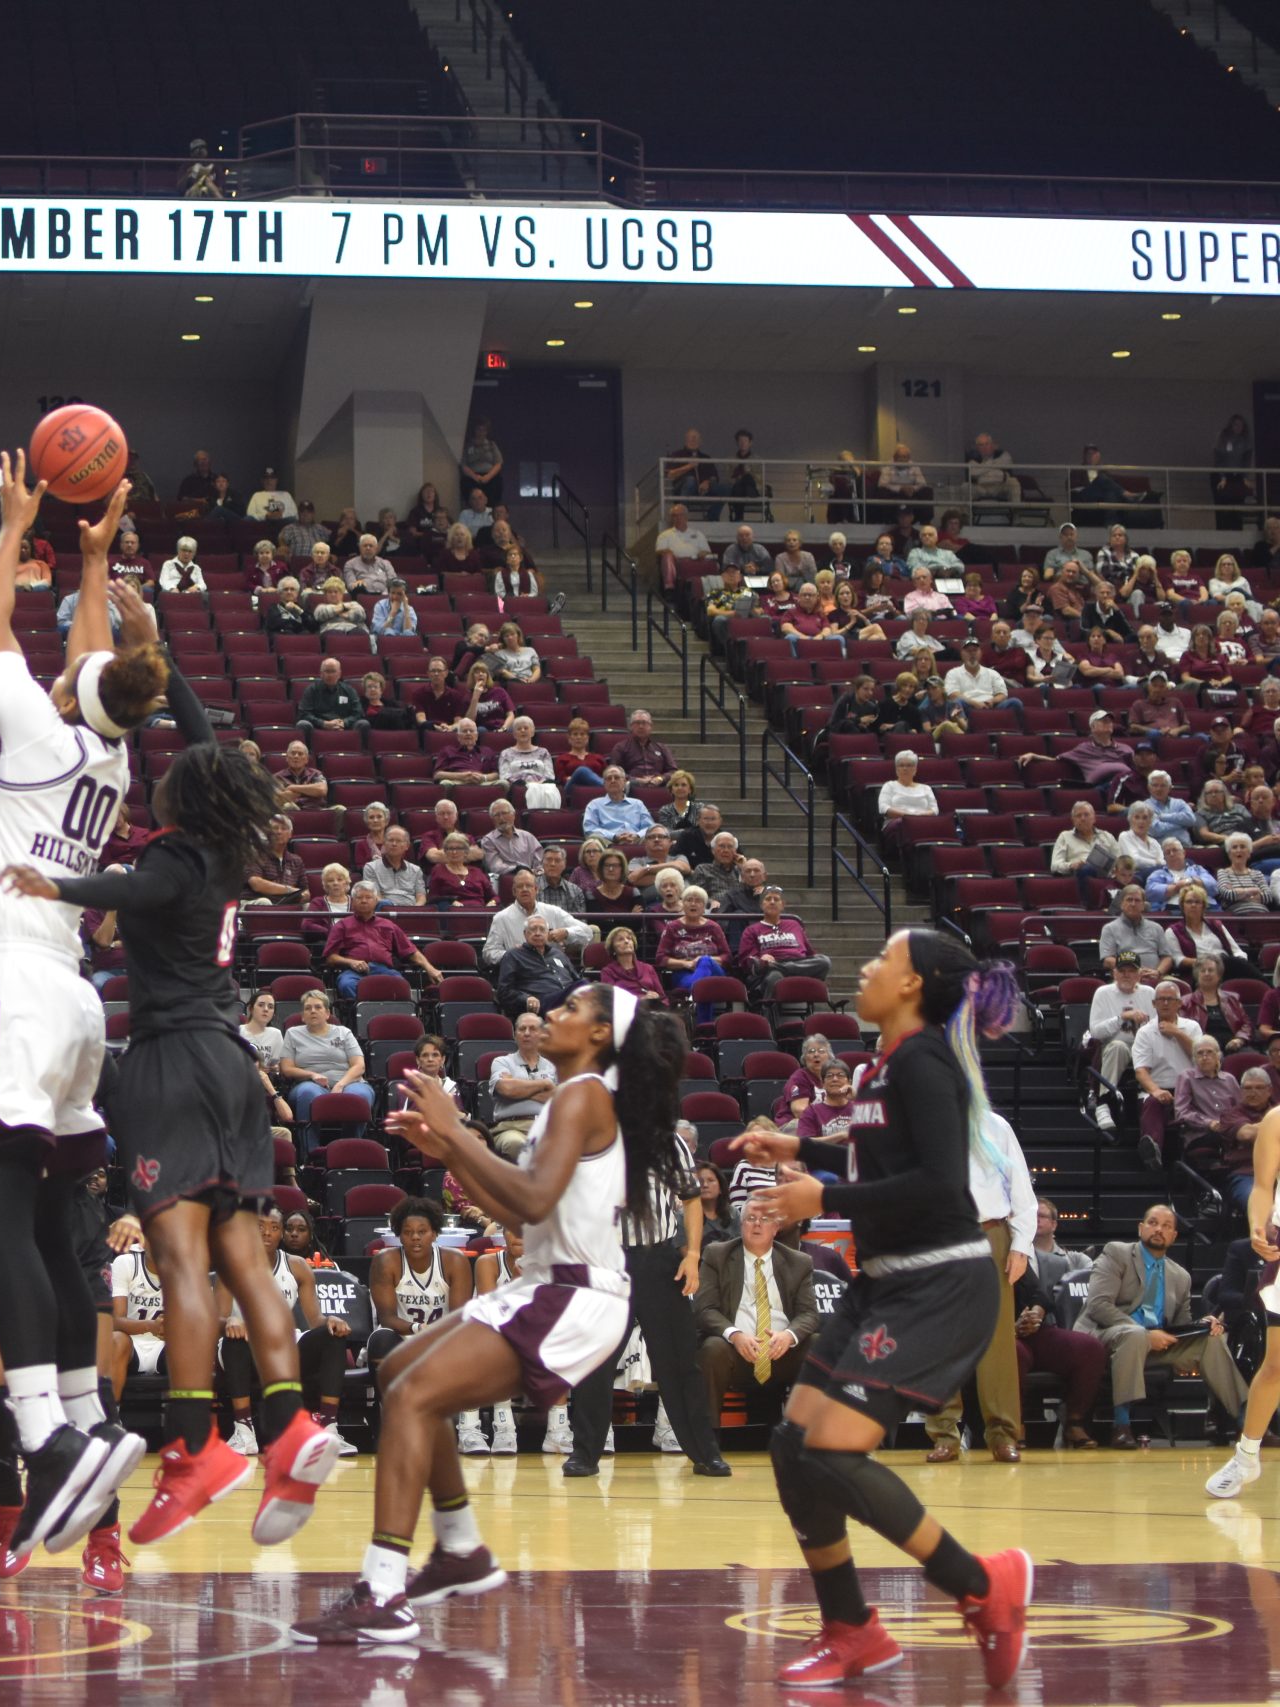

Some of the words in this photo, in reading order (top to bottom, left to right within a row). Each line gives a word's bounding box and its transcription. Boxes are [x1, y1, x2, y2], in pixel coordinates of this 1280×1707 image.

[168, 210, 283, 263] 17TH
[331, 212, 351, 264] 7
[383, 214, 448, 266] PM
[480, 215, 556, 269] VS.
[586, 217, 714, 272] UCSB
[903, 379, 942, 398] 121
[61, 774, 118, 851] 00
[315, 1283, 357, 1299] SCLE
[813, 1283, 843, 1299] CLE
[129, 1294, 161, 1308] TEXAS
[321, 1299, 350, 1314] ILK.
[399, 1294, 430, 1306] TEXAS
[815, 1299, 835, 1314] LK
[407, 1307, 442, 1325] 34
